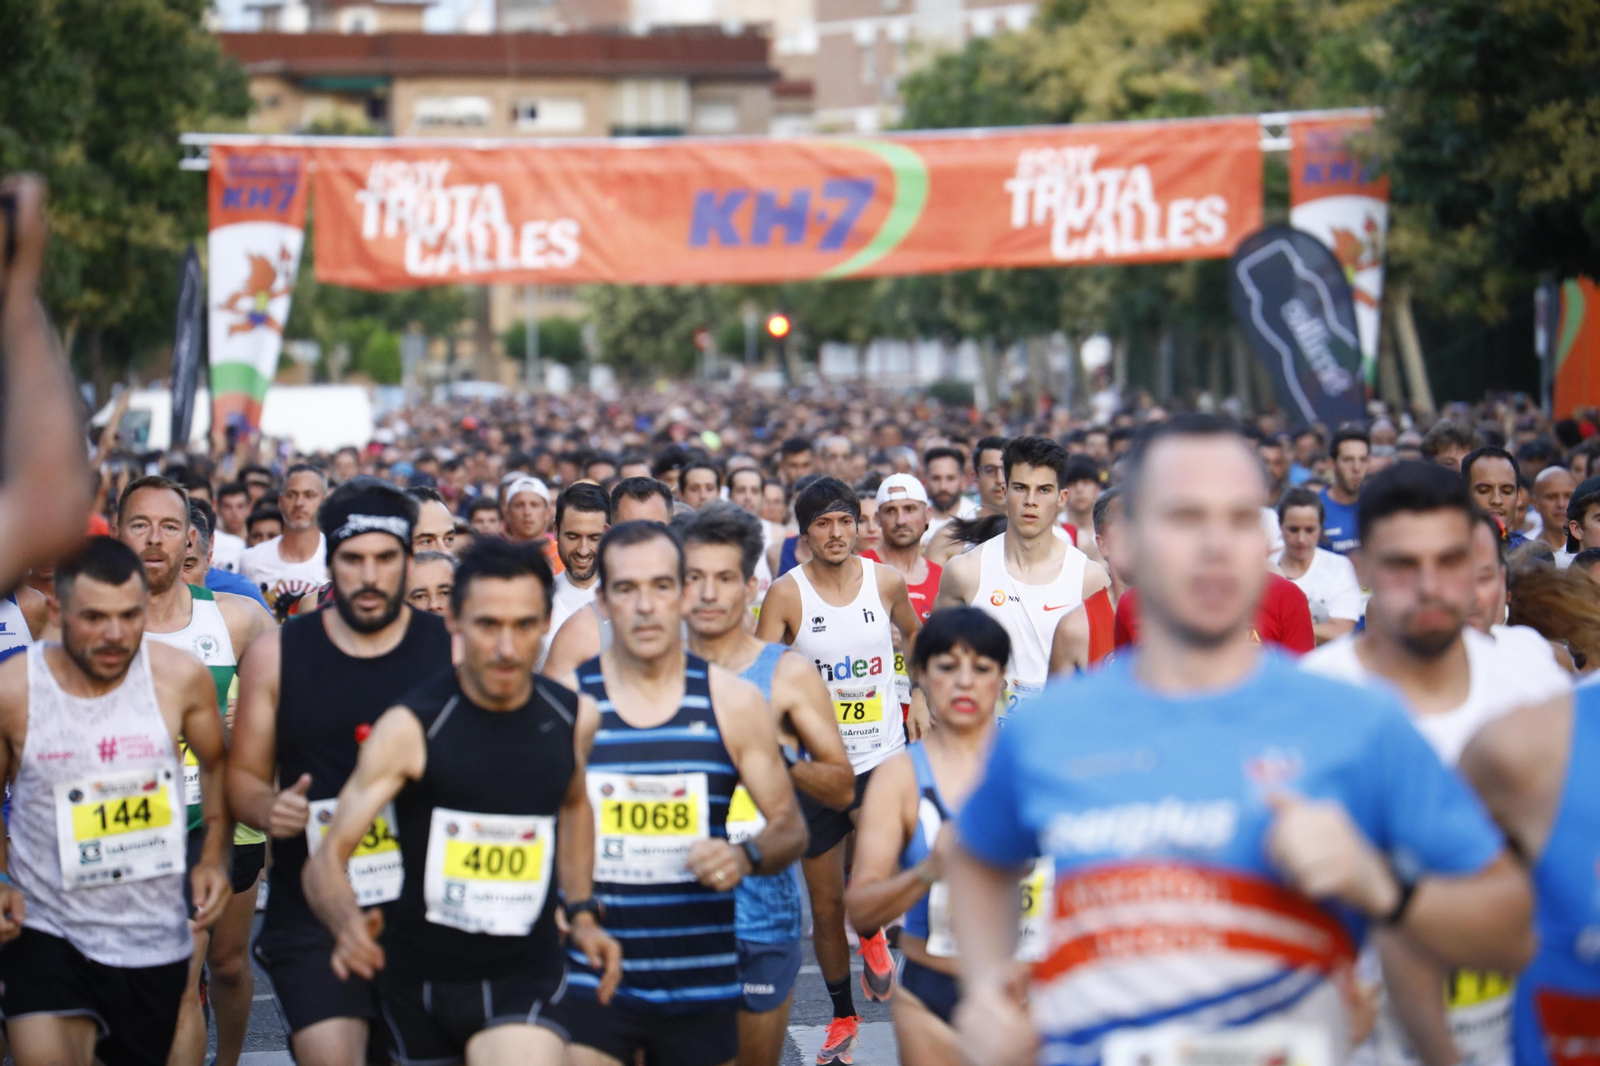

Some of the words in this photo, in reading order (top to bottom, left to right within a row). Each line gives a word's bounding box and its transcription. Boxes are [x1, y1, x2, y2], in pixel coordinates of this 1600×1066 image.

[1002, 164, 1156, 231] TROTA
[354, 183, 508, 246] TROTA
[1051, 194, 1229, 262] CALLES
[404, 217, 581, 278] CALLES
[863, 608, 875, 623] in
[814, 655, 883, 681] indea
[839, 702, 865, 721] 78
[93, 798, 152, 831] 144
[609, 803, 690, 831] 1068
[463, 846, 527, 873] 400
